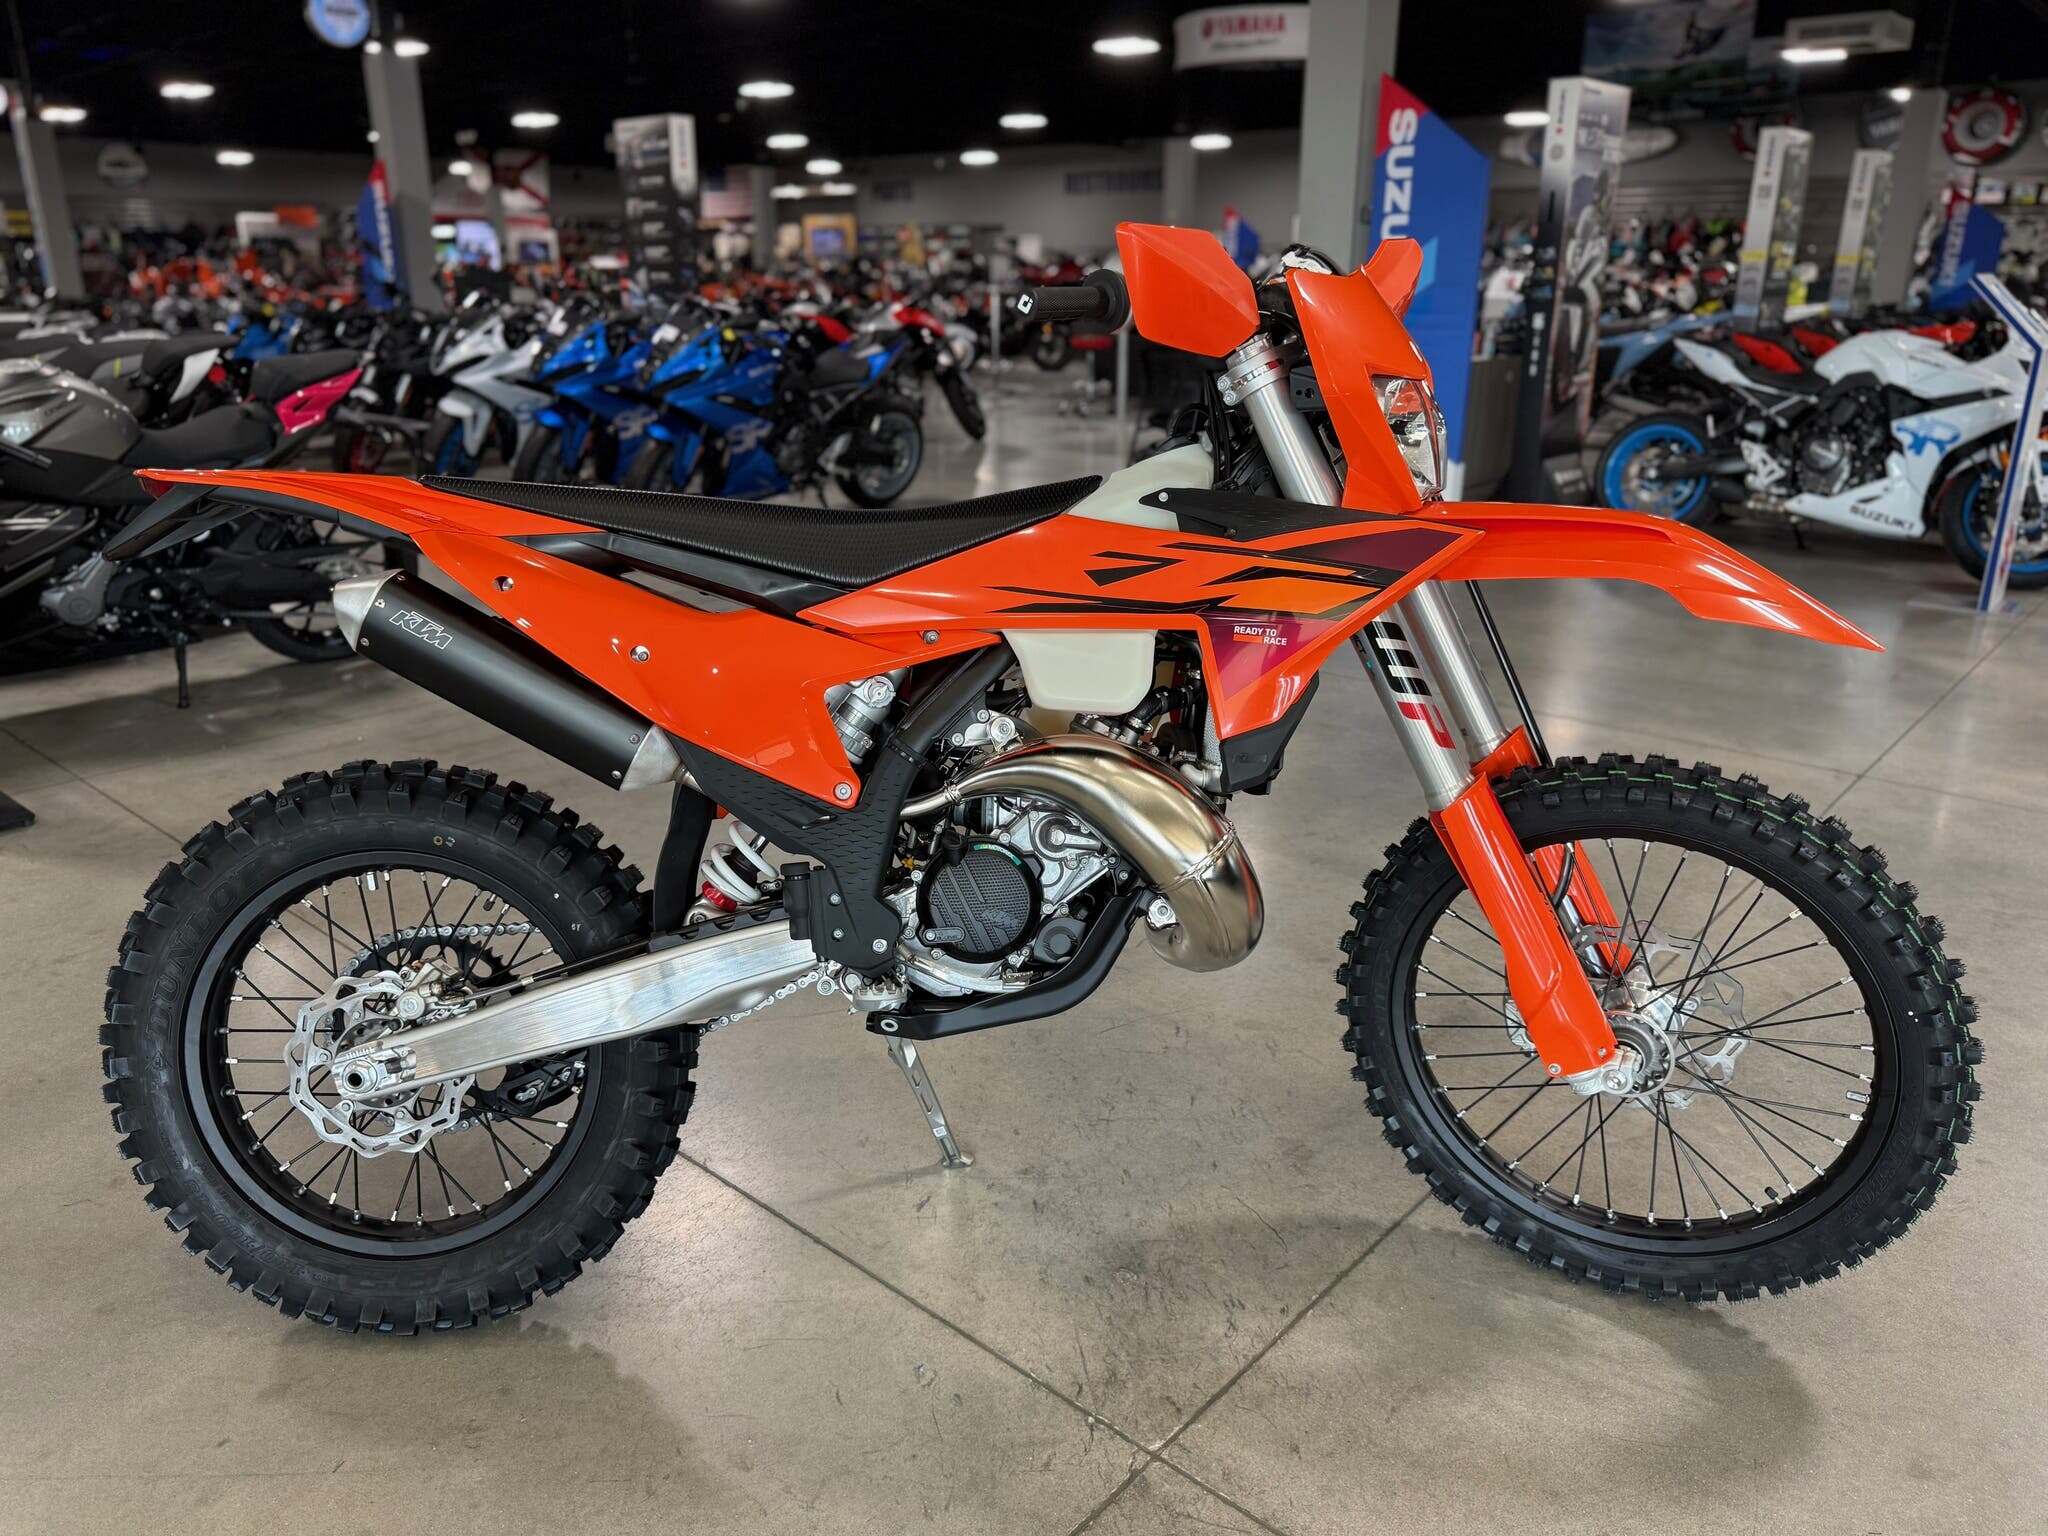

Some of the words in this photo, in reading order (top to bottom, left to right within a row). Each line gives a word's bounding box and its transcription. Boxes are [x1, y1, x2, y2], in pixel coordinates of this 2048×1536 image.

[1850, 503, 1914, 531] SUZUKI
[389, 609, 453, 650] KTM
[1233, 626, 1263, 635] READY
[1265, 629, 1277, 637] TO
[1263, 637, 1287, 646] RACE
